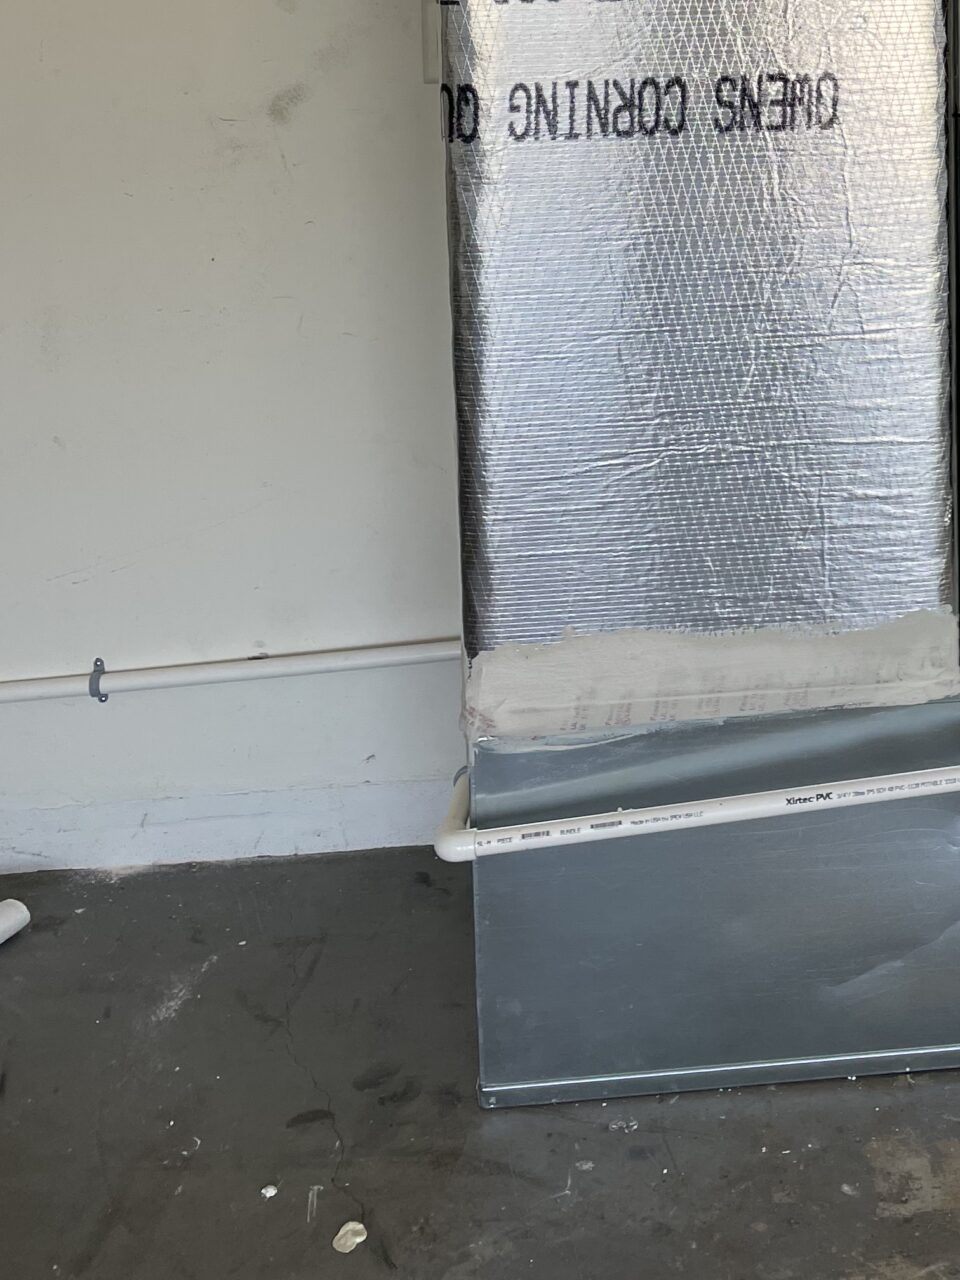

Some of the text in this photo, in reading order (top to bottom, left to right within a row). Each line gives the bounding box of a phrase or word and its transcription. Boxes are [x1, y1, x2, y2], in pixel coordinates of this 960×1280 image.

[508, 76, 688, 141] CORNING
[714, 71, 839, 133] OWENS
[815, 791, 833, 802] PVC
